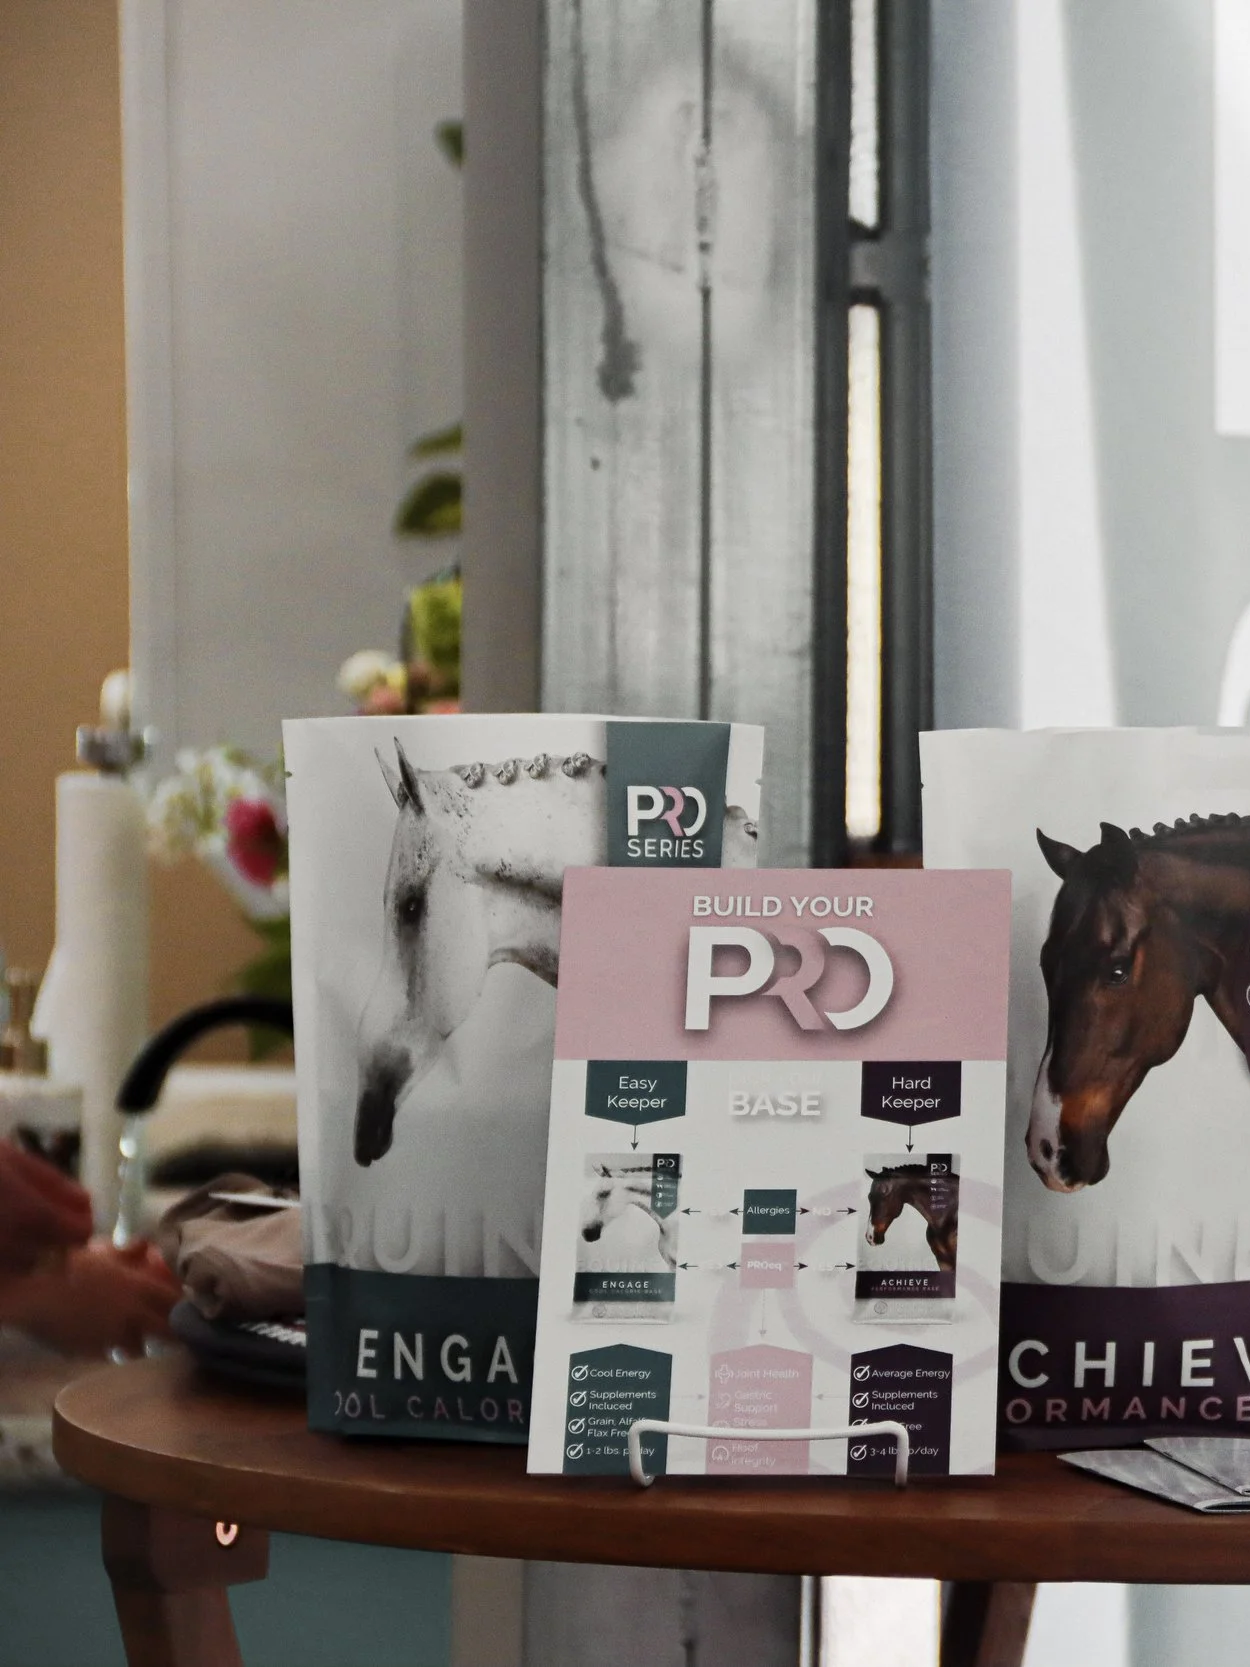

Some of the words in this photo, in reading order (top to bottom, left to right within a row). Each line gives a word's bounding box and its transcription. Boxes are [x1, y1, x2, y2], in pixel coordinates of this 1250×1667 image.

[626, 785, 707, 837] PRO
[627, 838, 704, 858] SERIES
[693, 895, 782, 918] BUILD
[790, 895, 874, 918] YOUR
[685, 926, 894, 1030] PRO
[618, 1076, 658, 1093] Easy
[891, 1075, 932, 1091] Hard
[607, 1095, 668, 1112] Keeper
[728, 1090, 822, 1117] BASE
[881, 1095, 942, 1111] Keeper
[746, 1206, 790, 1216] Allergies
[747, 1260, 782, 1271] PROeq
[881, 1278, 929, 1286] ACHIEVE
[356, 1328, 518, 1384] ENGA
[589, 1368, 614, 1378] Cool
[615, 1369, 651, 1380] Energy
[763, 1369, 800, 1379] Health
[871, 1369, 913, 1380] Average
[915, 1369, 951, 1380] Energy
[589, 1390, 657, 1400] Supplements
[872, 1390, 938, 1400] Supplements
[407, 1395, 524, 1424] CALOR
[588, 1402, 633, 1411] Included
[734, 1403, 778, 1414] Support
[871, 1402, 915, 1411] Included
[587, 1429, 609, 1438] Flax
[587, 1447, 602, 1455] 1-2
[622, 1446, 655, 1457] pay
[870, 1447, 886, 1457] 3-4
[888, 1446, 898, 1455] lb
